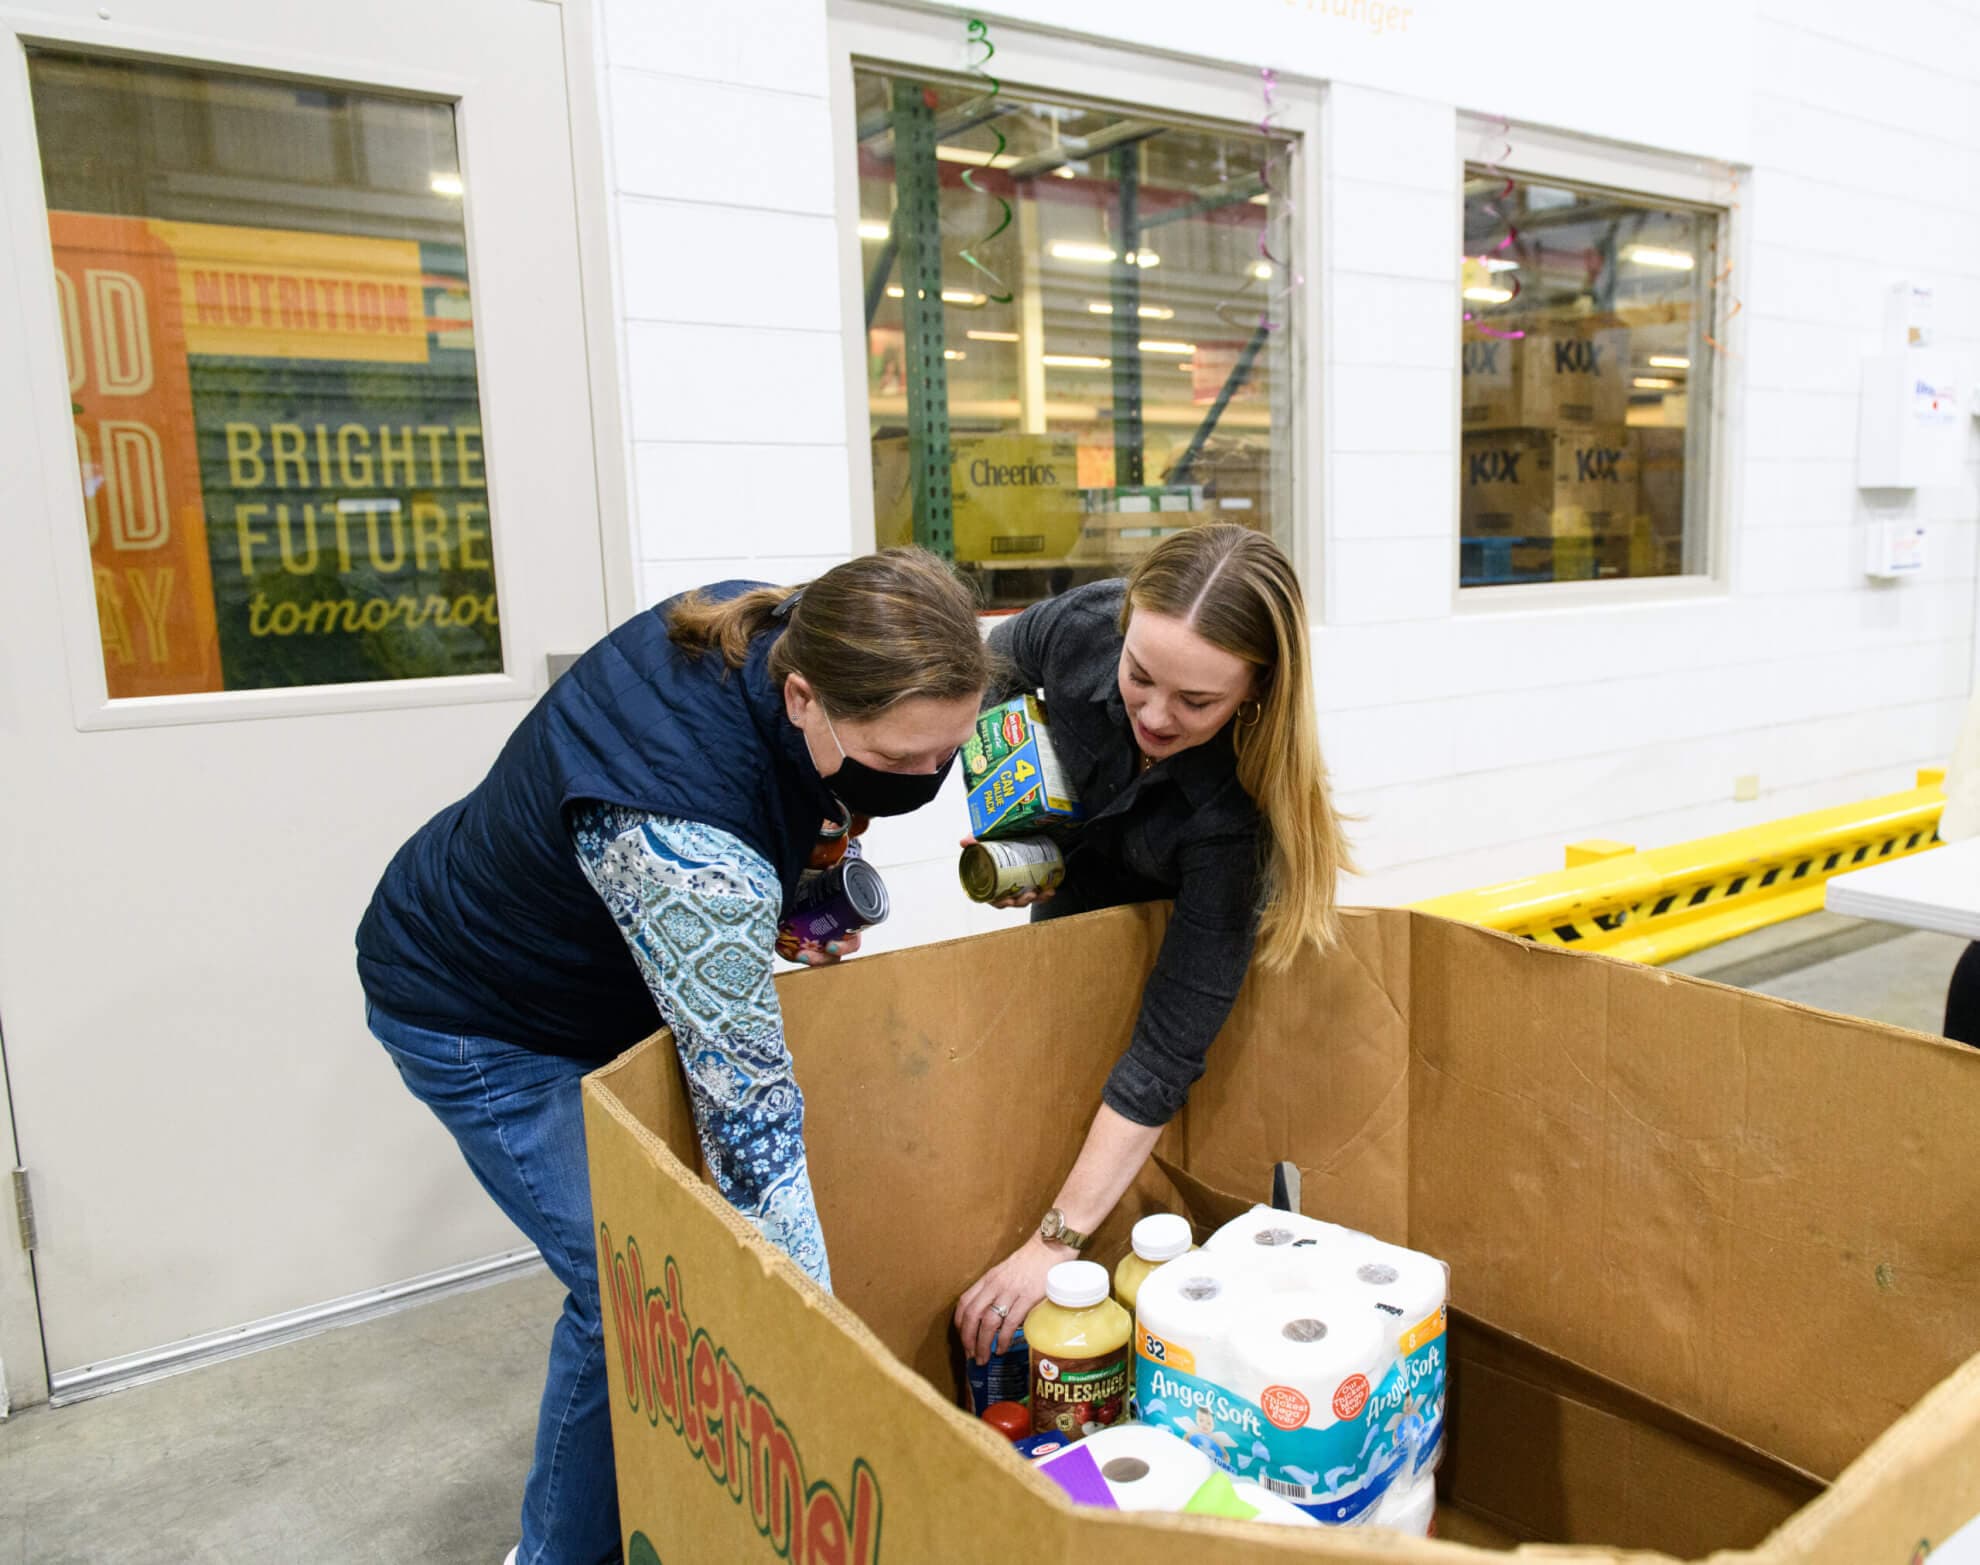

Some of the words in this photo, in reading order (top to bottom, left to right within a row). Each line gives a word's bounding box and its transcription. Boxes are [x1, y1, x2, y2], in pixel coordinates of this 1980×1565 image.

[193, 271, 416, 334] NUTRITION
[1554, 340, 1602, 377] KIX
[224, 421, 486, 489] BRIGHTE
[970, 457, 1057, 488] Cheerios
[1470, 449, 1521, 486] KIX
[1575, 448, 1621, 483] KIX
[234, 502, 490, 576] FUTURE
[1000, 770, 1015, 797] CAN
[1014, 759, 1036, 782] 4
[983, 790, 996, 815] PACK
[992, 781, 1005, 807] VALUE
[1145, 1335, 1166, 1361] 32
[1036, 1372, 1125, 1403] APPLESAUCE
[1150, 1370, 1216, 1415] Angel
[1216, 1397, 1262, 1437] Soft
[1366, 1362, 1412, 1427] Angel
[1411, 1346, 1440, 1389] Soft
